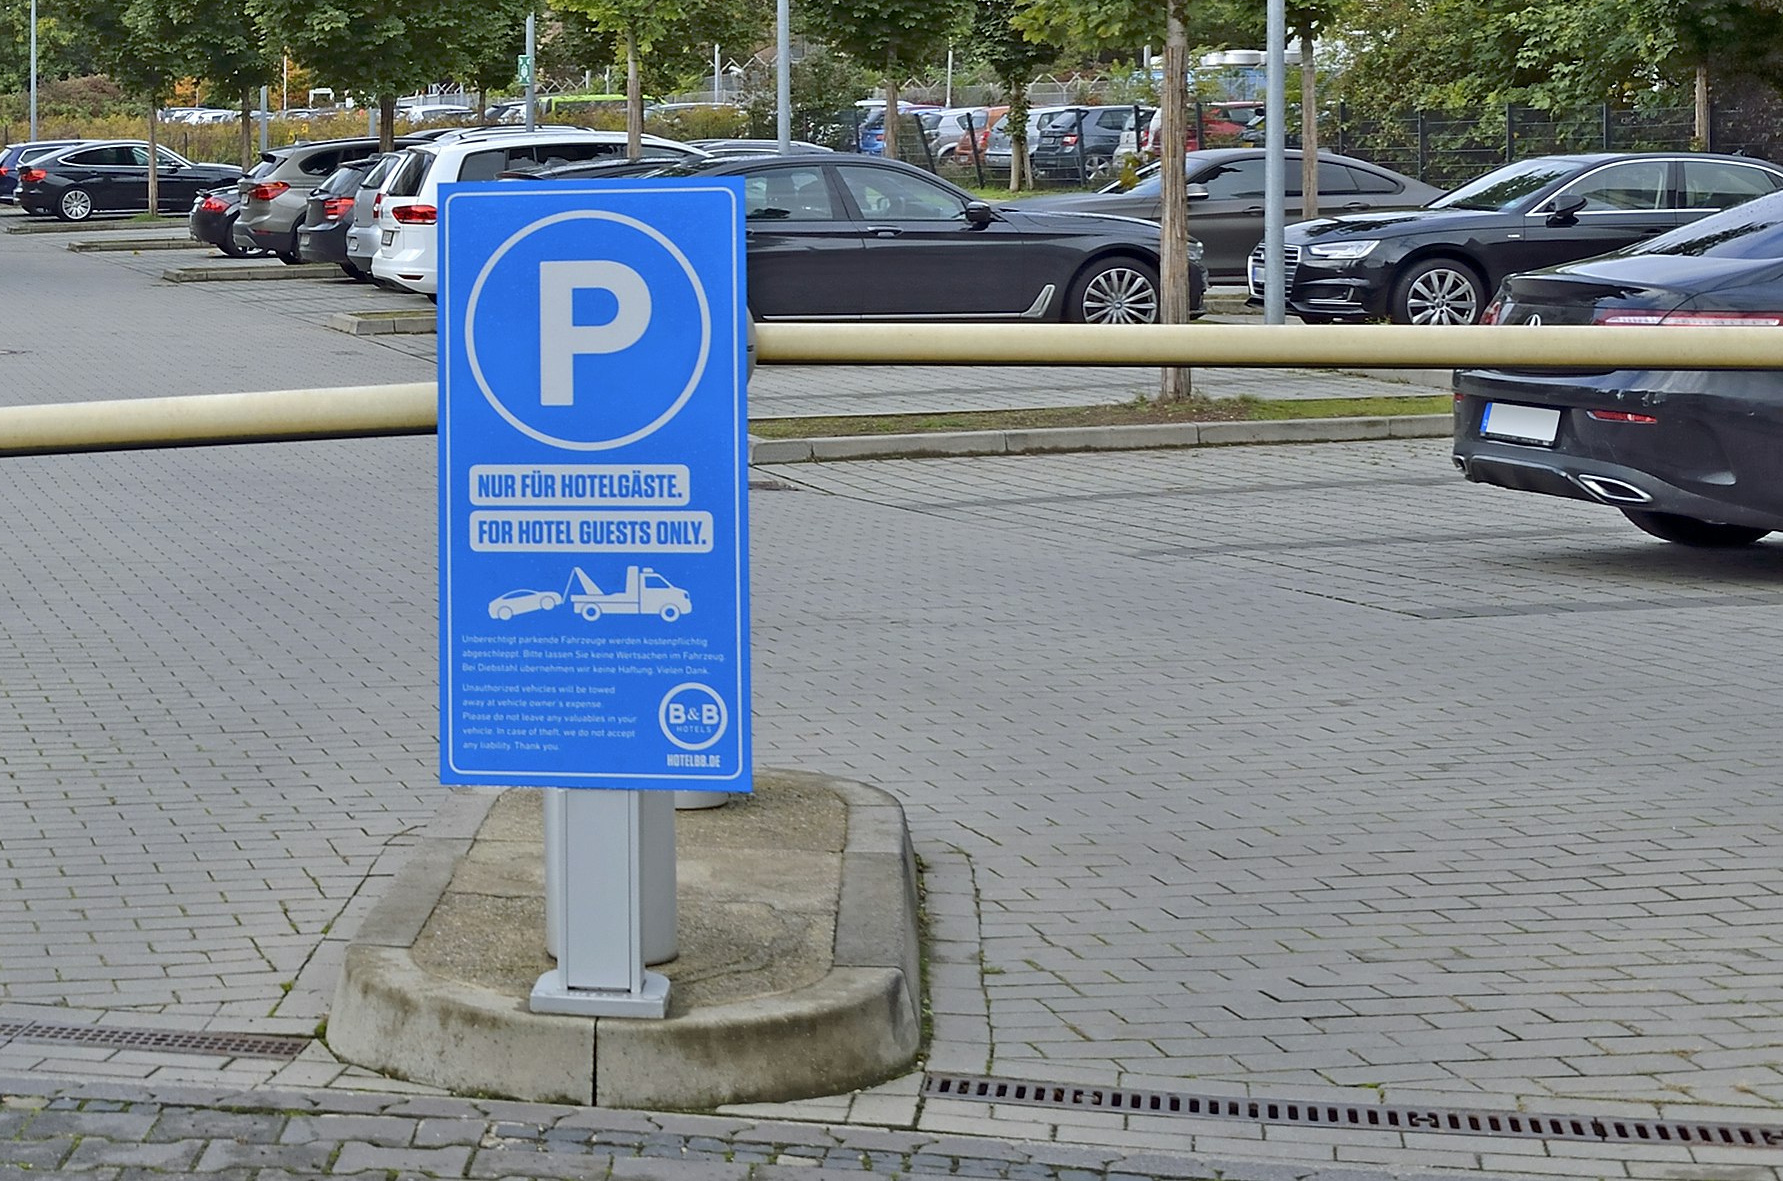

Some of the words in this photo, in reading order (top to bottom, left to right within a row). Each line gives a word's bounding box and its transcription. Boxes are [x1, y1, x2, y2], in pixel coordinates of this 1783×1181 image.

[539, 259, 653, 407] P
[477, 473, 517, 499] NUR
[521, 469, 557, 499] FÜR
[561, 469, 684, 499] HOTELGÄSTE.
[477, 519, 514, 545] FOR
[518, 519, 575, 545] HOTEL
[578, 520, 652, 546] GUESTS
[656, 520, 708, 546] ONLY.
[462, 634, 517, 646] Unberechtigt
[518, 636, 559, 645] parkende
[560, 635, 607, 646] Fahrzeuge
[609, 637, 641, 645] werden
[643, 637, 708, 648] kostenpflichtig
[522, 649, 544, 658] Bitte
[545, 649, 574, 659] lassen
[575, 650, 590, 659] Sie
[591, 651, 615, 659] keine
[616, 651, 668, 660] Wertsachen
[477, 662, 518, 672] Diebstahl
[592, 665, 617, 674] keine
[656, 666, 684, 675] Vielen
[462, 683, 520, 693] Unauthorized
[521, 683, 557, 693] vehicles
[558, 685, 574, 694] will
[575, 685, 587, 694] be
[588, 686, 616, 694] towed
[462, 699, 484, 708] away
[486, 699, 495, 707] at
[497, 698, 528, 707] vehicle
[462, 711, 491, 721] Please
[493, 712, 505, 721] do
[505, 713, 520, 721] not
[521, 713, 545, 722] leave
[546, 714, 562, 723] any
[563, 714, 606, 723] valuables
[607, 715, 616, 723] in
[617, 715, 637, 724] your
[669, 703, 720, 725] B&B
[496, 727, 505, 735] In
[506, 727, 527, 736] case
[528, 727, 537, 736] of
[563, 729, 576, 737] we
[577, 729, 590, 737] do
[590, 729, 605, 737] not
[606, 729, 636, 739] accept
[676, 725, 712, 733] HOTELS
[462, 742, 478, 751] any
[514, 740, 541, 750] Thank
[666, 753, 721, 769] HOTELBB.DE
